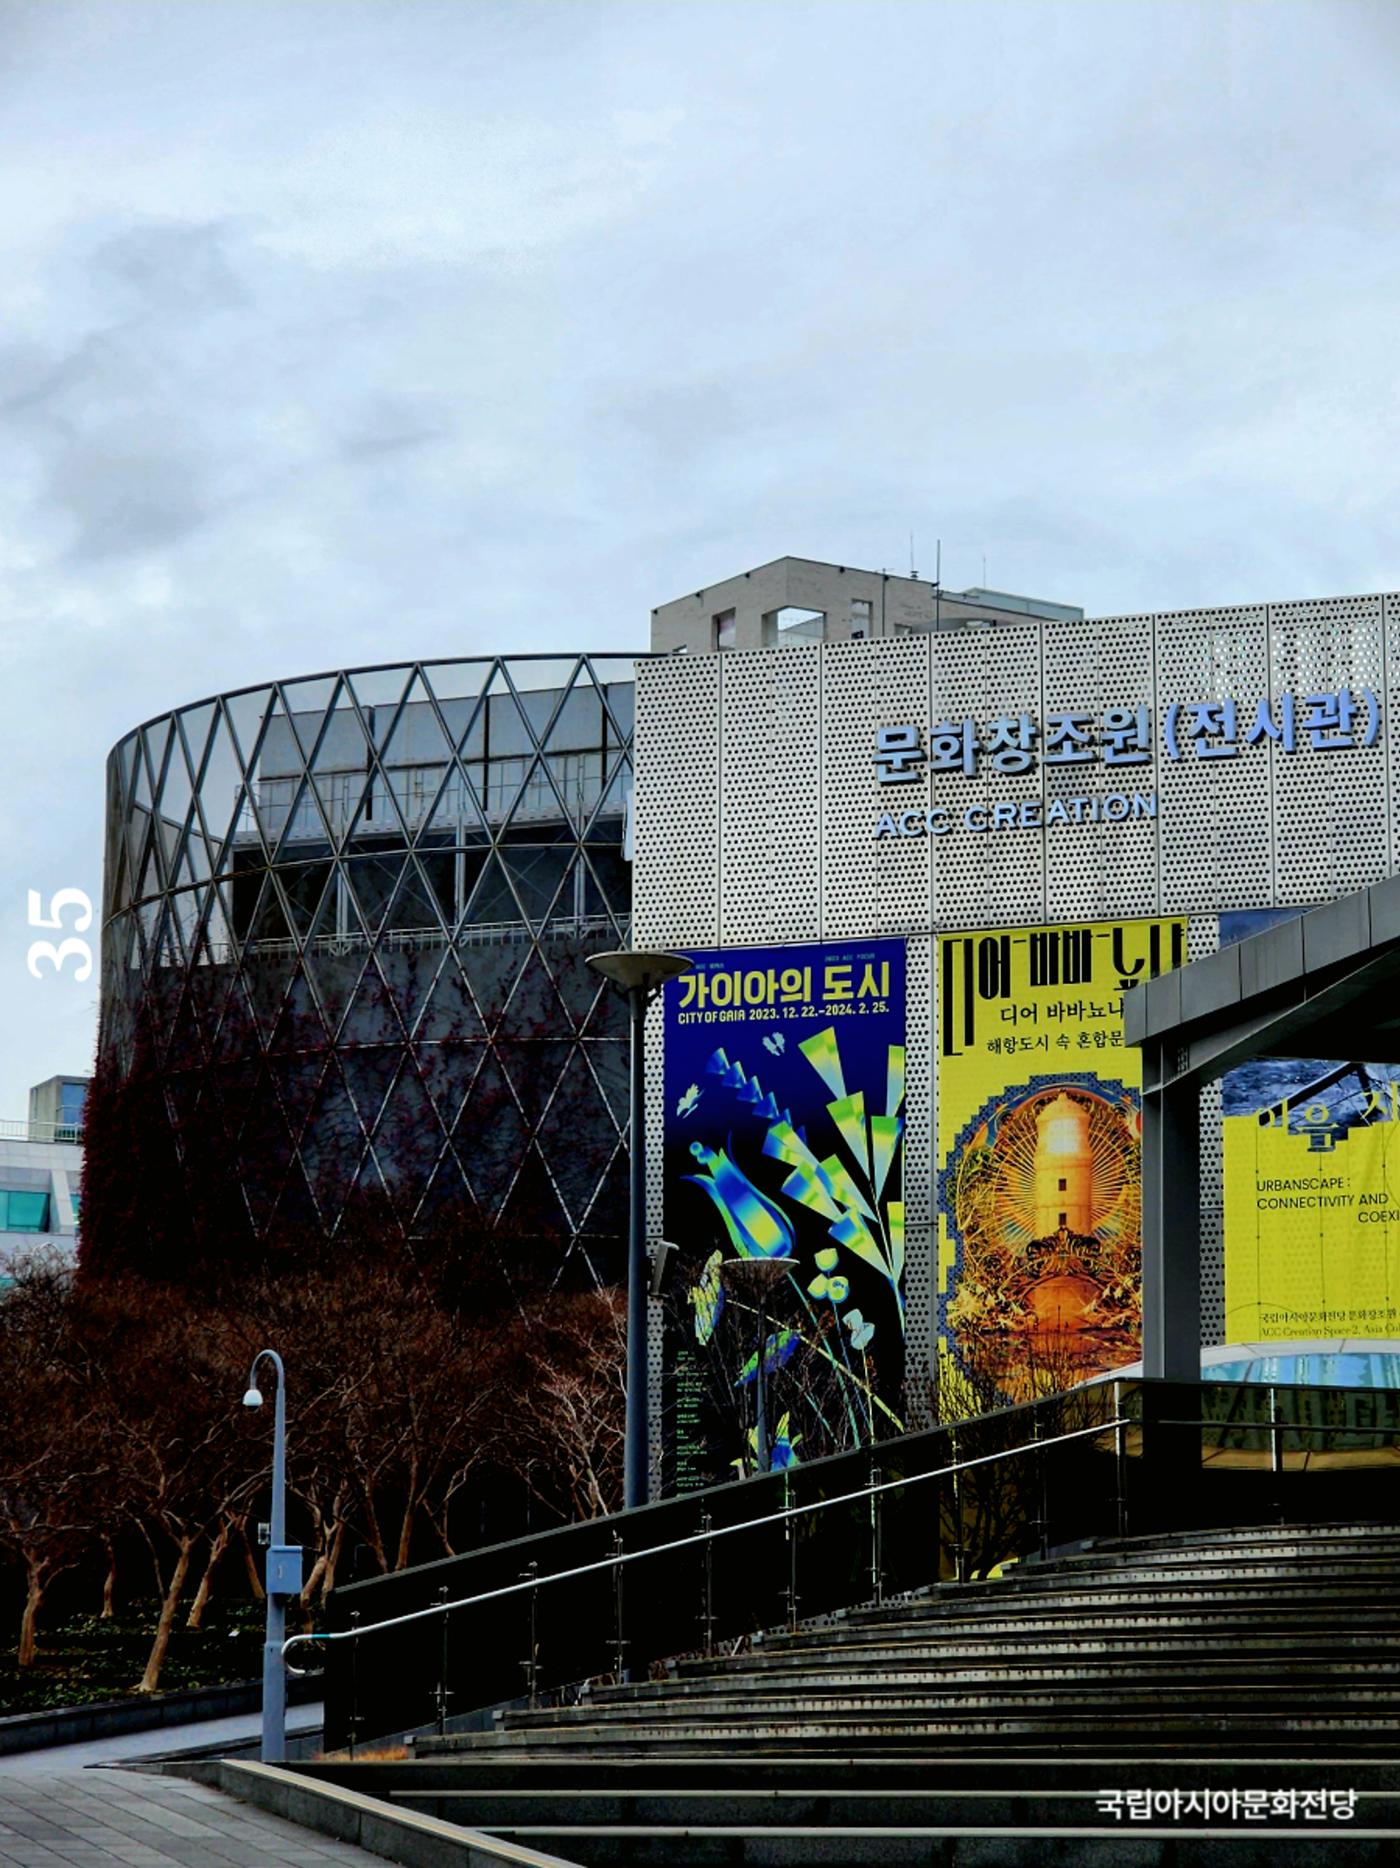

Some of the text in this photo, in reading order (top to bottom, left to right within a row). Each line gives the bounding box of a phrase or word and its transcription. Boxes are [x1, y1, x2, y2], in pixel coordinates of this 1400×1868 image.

[873, 793, 1158, 839] ACC CREATION
[678, 962, 890, 1008] 가이아의 도시
[678, 1011, 702, 1024] CITY
[704, 1010, 718, 1023] OF
[719, 1009, 745, 1022] GAIA
[749, 1008, 779, 1021] 2023.
[873, 1001, 890, 1013] 25.
[1001, 1002, 1037, 1025] 디어
[987, 1034, 1048, 1054] 해항도시
[1056, 1033, 1070, 1049] 속
[1256, 1177, 1344, 1192] URBANSCAPE
[1257, 1193, 1389, 1210] CONNECTIVITY AND
